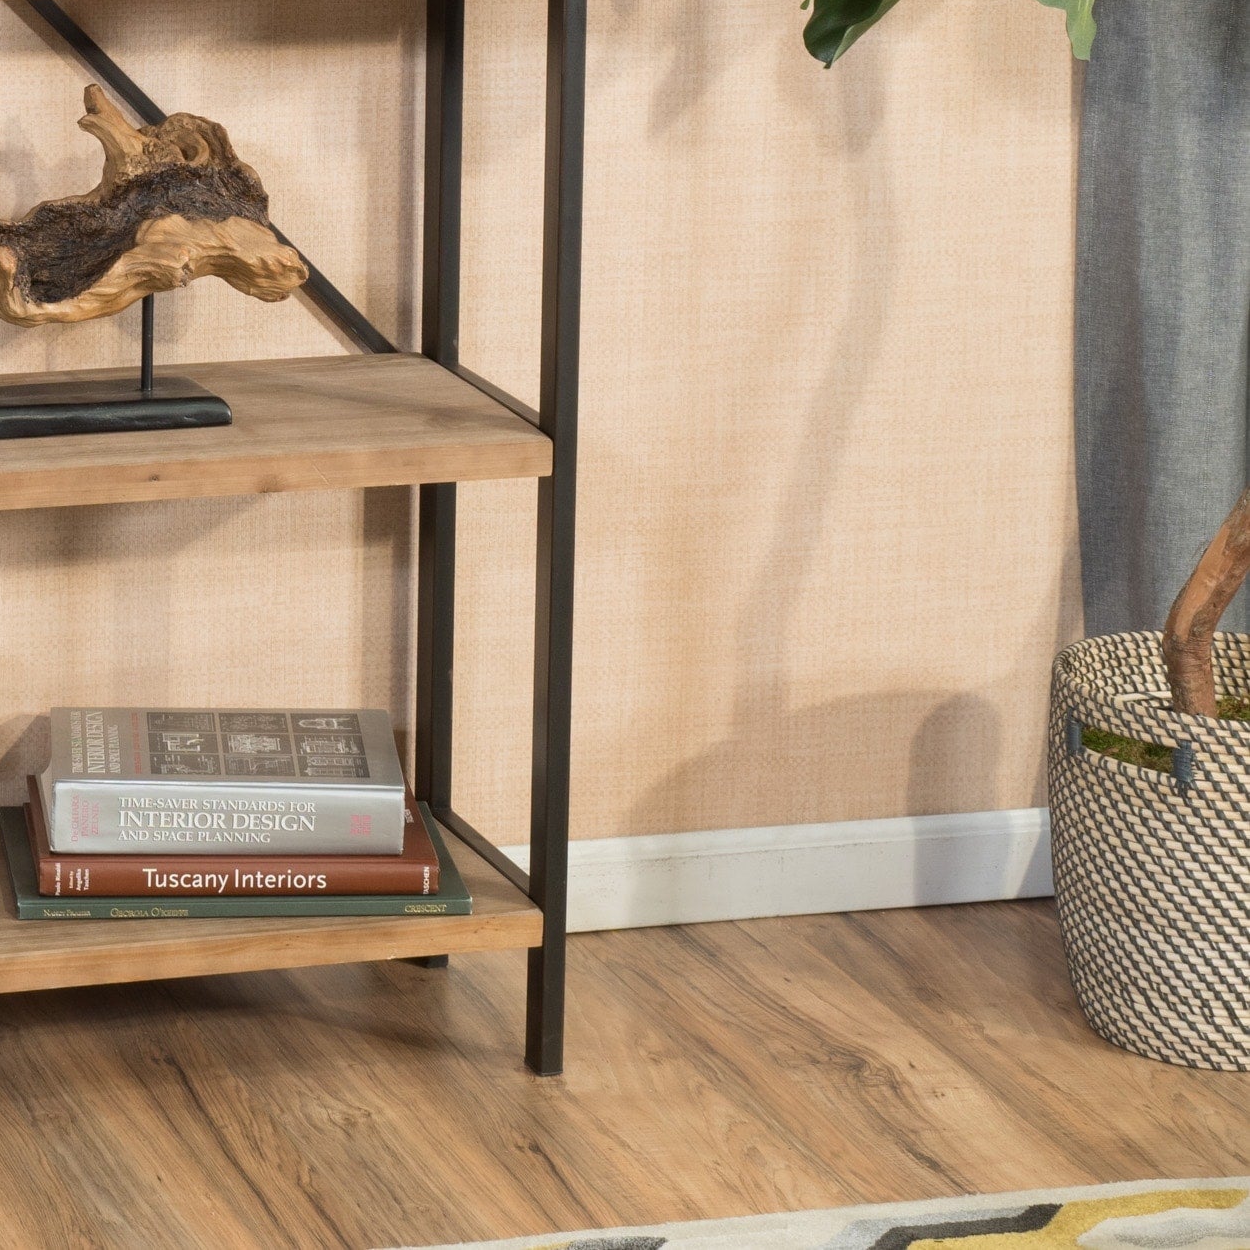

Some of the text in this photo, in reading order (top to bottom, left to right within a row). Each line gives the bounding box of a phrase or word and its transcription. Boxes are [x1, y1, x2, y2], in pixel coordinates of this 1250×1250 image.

[86, 710, 106, 774] INTERIOR DESIGN
[118, 797, 316, 813] TIME-SAVER STANDARDS FOR
[118, 810, 316, 832] INTERIOR DESIGN
[118, 830, 271, 843] AND SPACE PLANNING
[142, 868, 327, 893] Tuscany Interiors
[404, 904, 447, 914] CRESCENT
